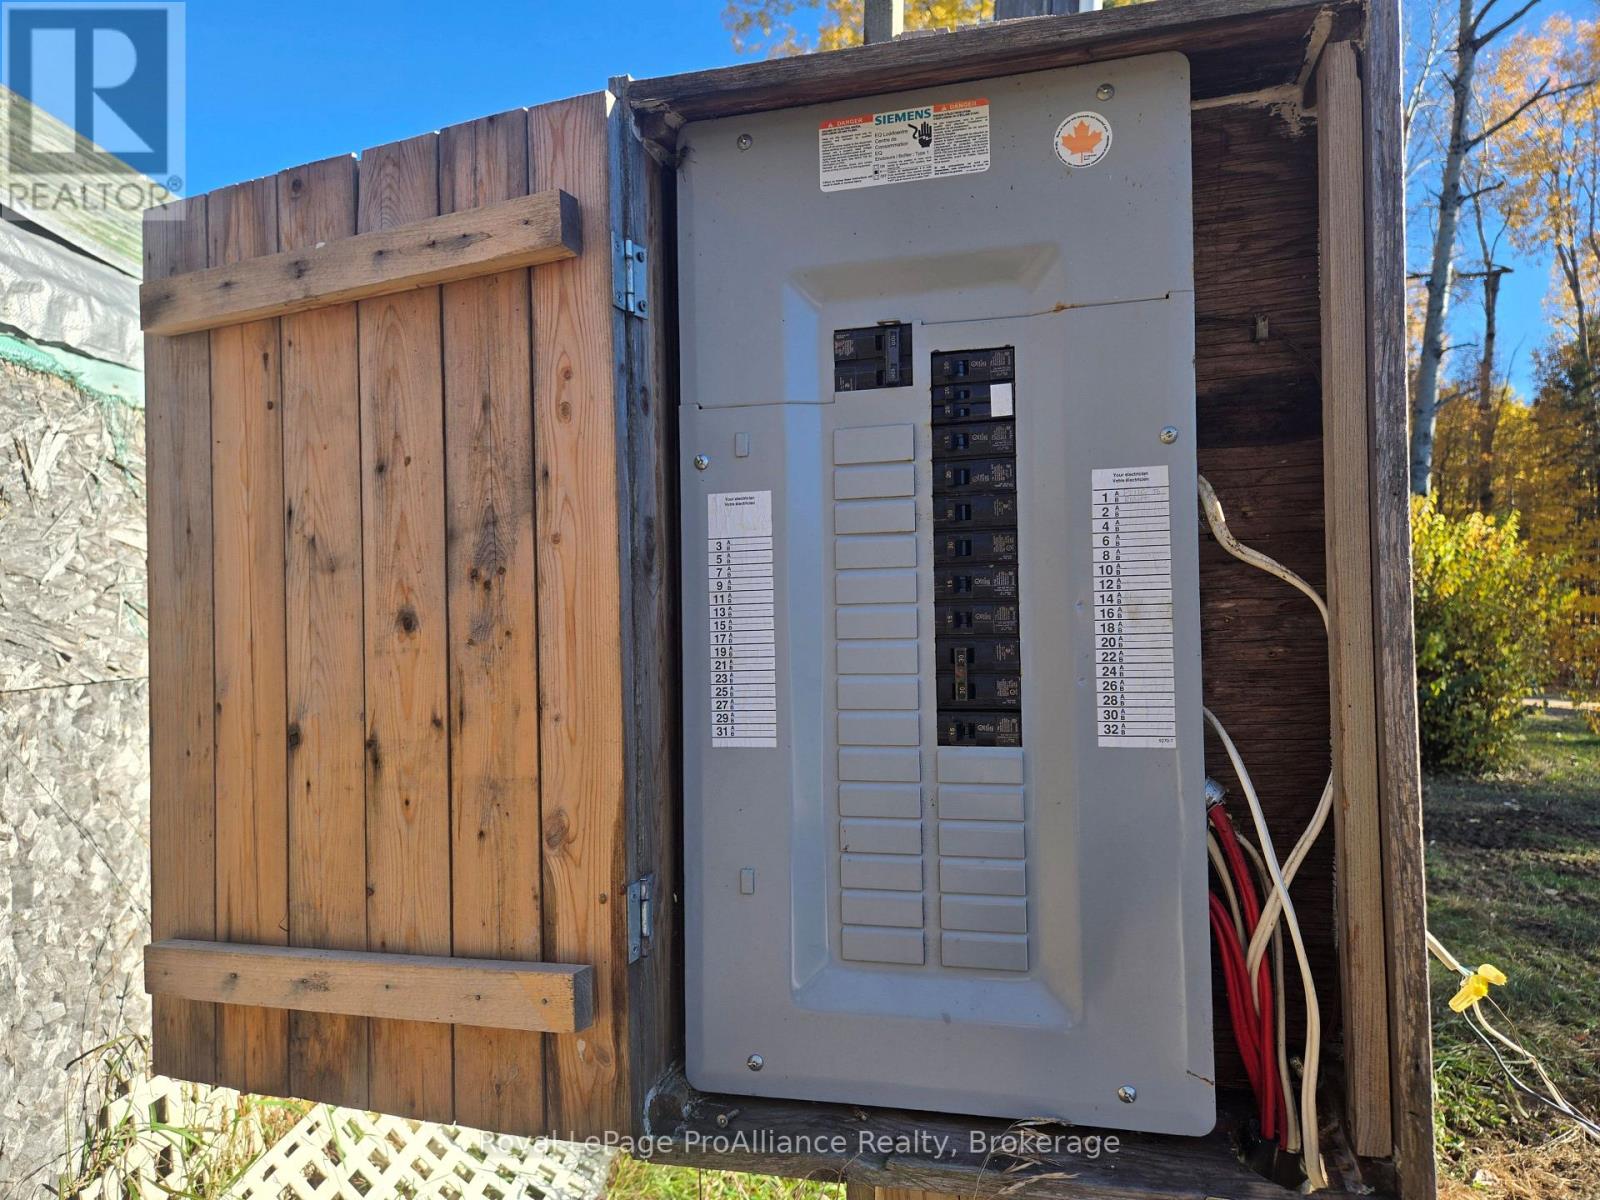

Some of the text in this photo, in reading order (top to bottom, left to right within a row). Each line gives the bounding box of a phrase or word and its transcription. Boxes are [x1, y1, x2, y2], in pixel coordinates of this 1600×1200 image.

[875, 108, 931, 126] SIEMENS
[836, 117, 863, 128] DANGER
[1103, 493, 1107, 502] 1
[1102, 507, 1109, 517] 2
[1102, 522, 1109, 531] 4
[1103, 536, 1109, 546] 6
[716, 542, 722, 550] 3
[717, 555, 722, 564] 5
[1103, 551, 1109, 560] 8
[717, 568, 722, 577] 7
[1099, 565, 1113, 575] 10
[717, 581, 722, 590] 9
[1100, 579, 1113, 589] 12
[714, 595, 723, 603] 11
[1100, 594, 1113, 604] 14
[714, 608, 725, 617] 13
[1100, 608, 1114, 618] 16
[714, 621, 726, 630] 15
[1101, 623, 1114, 633] 18
[715, 634, 726, 643] 17
[1101, 637, 1116, 647] 20
[715, 647, 726, 656] 19
[1102, 652, 1116, 662] 22
[715, 661, 726, 669] 21
[1103, 666, 1116, 676] 24
[716, 674, 727, 683] 23
[1103, 681, 1117, 691] 26
[716, 687, 728, 696] 25
[1103, 695, 1118, 705] 28
[716, 701, 728, 709] 27
[717, 714, 728, 722] 29
[1104, 710, 1118, 720] 30
[717, 727, 727, 736] 31
[1104, 724, 1118, 734] 32
